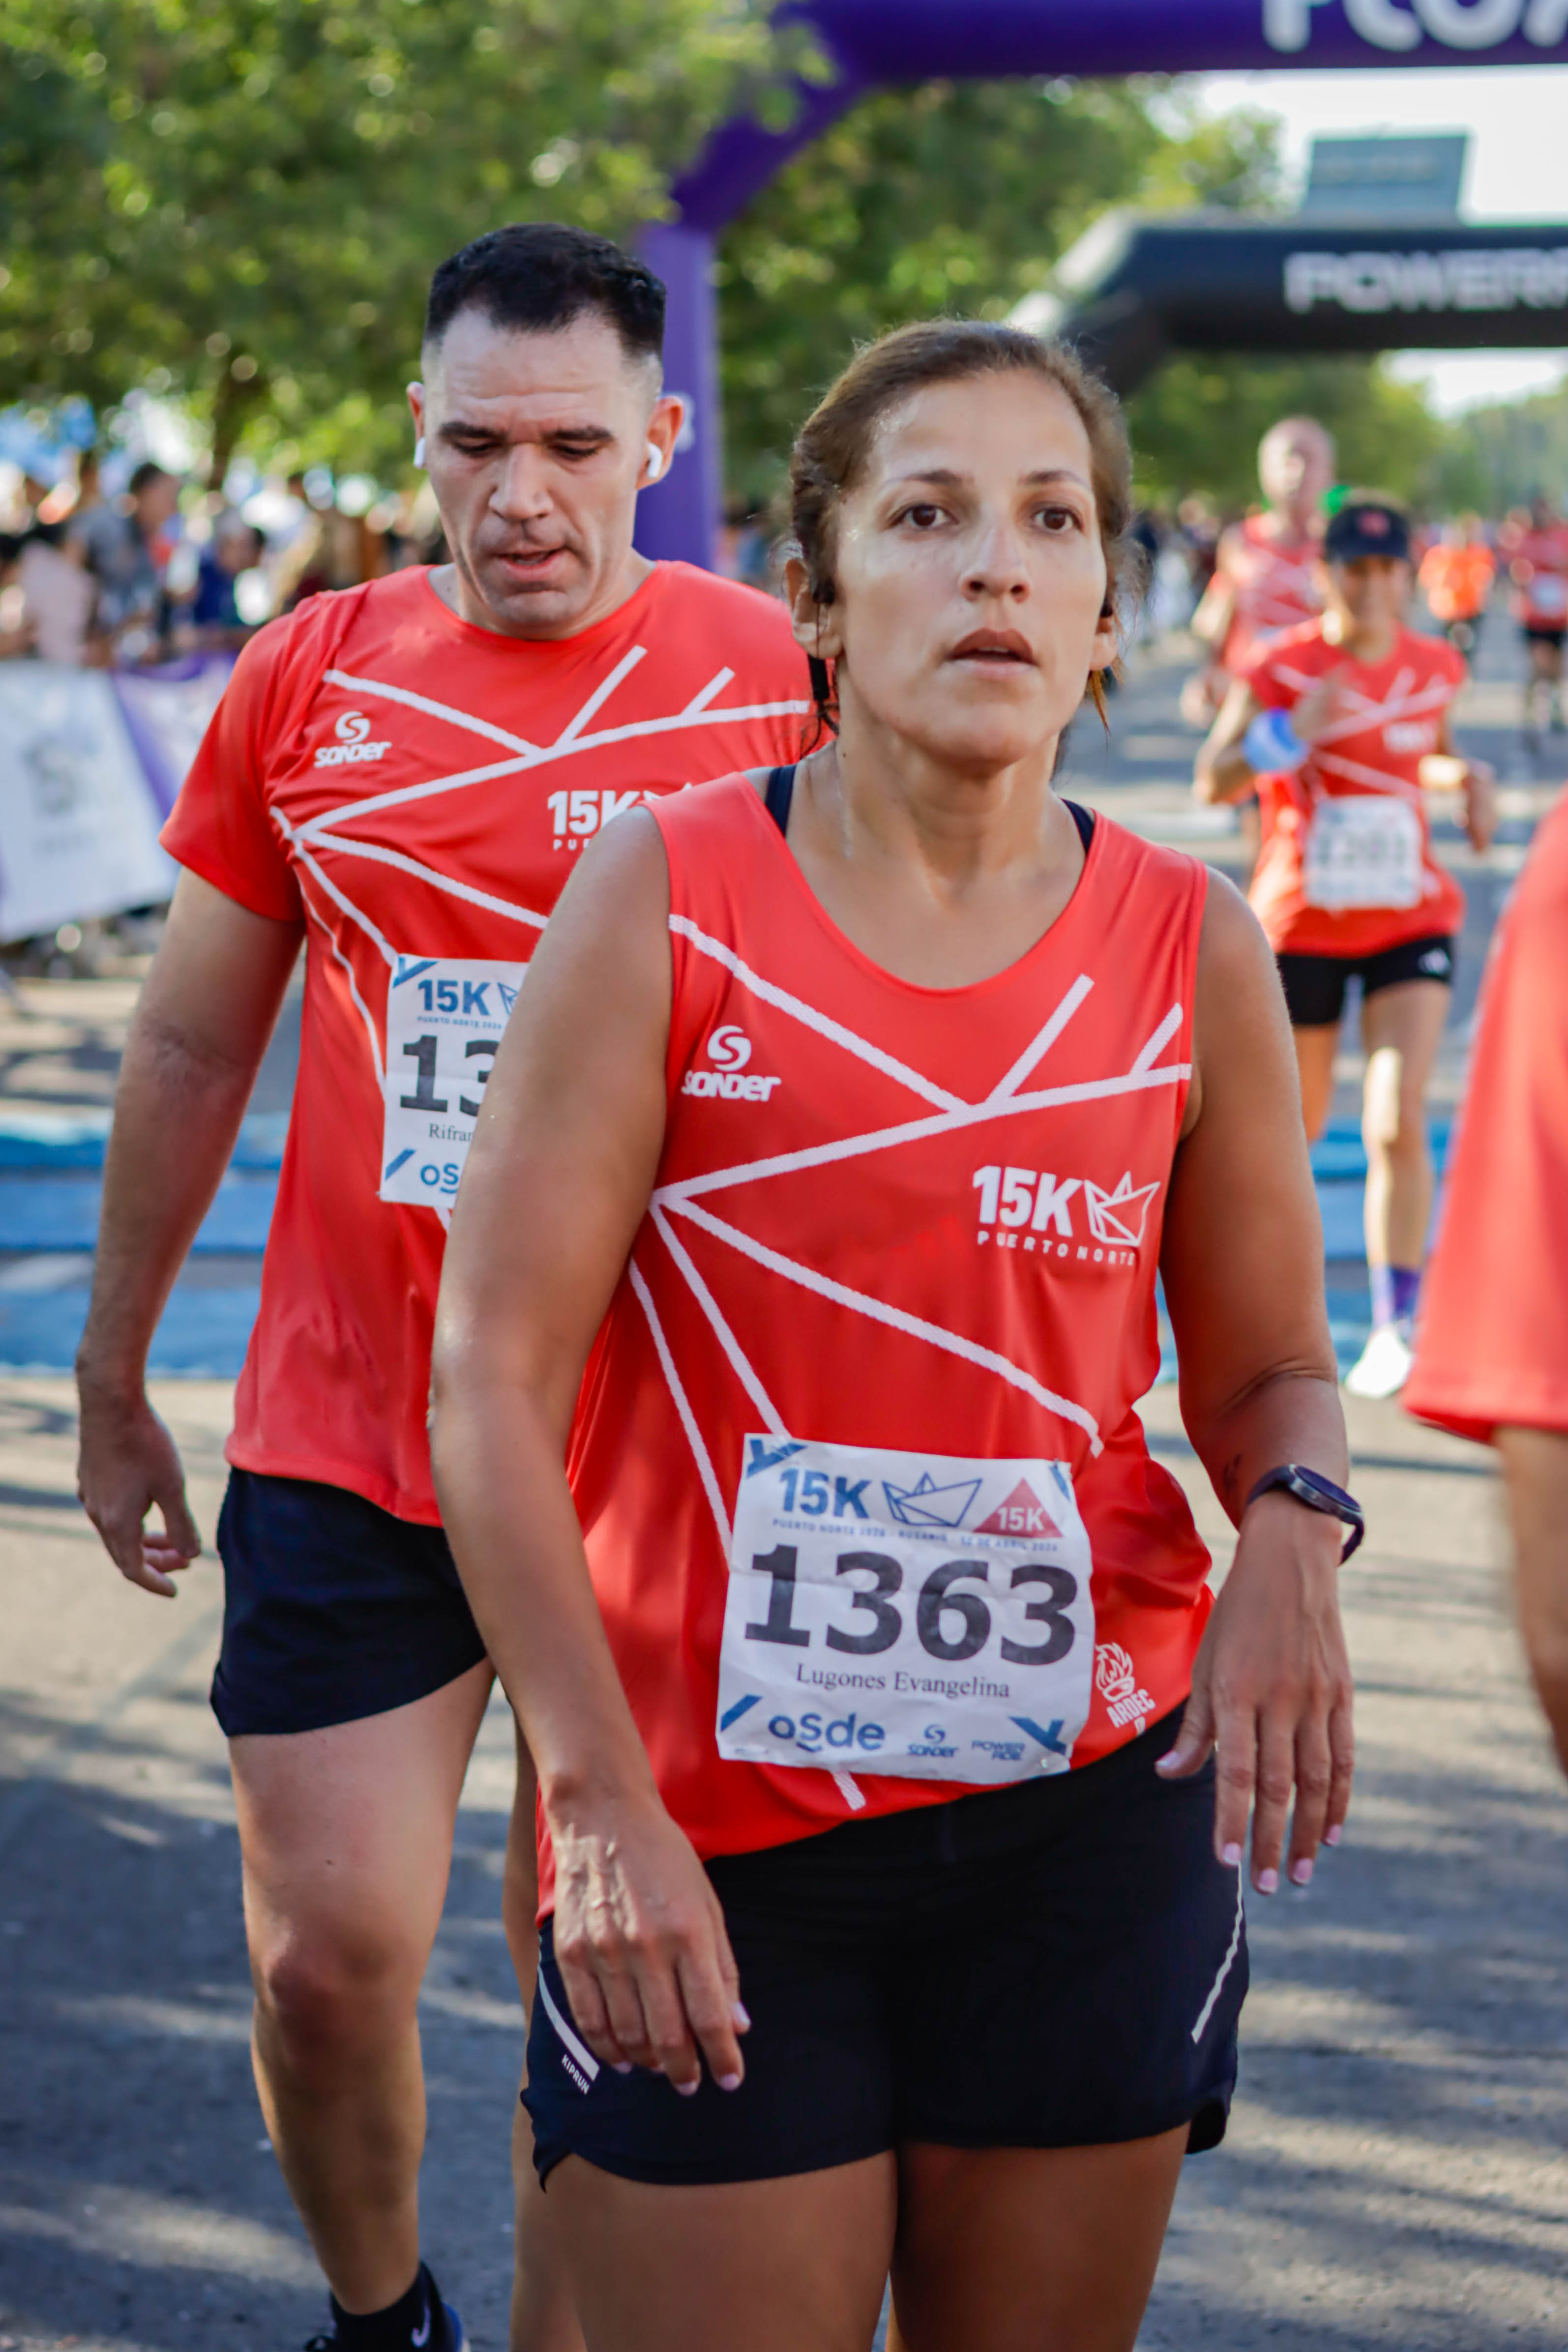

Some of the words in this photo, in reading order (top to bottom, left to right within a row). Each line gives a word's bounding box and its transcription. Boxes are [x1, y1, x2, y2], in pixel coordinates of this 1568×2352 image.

[547, 790, 641, 835] 15K
[418, 979, 491, 1016] 15K
[973, 1165, 1083, 1237] 15K
[977, 1230, 1068, 1258] PUERTO
[1076, 1245, 1135, 1266] NORTE
[779, 1468, 873, 1519] 15K
[997, 1506, 1045, 1531] 15K
[744, 1543, 1078, 1666] 1363
[796, 1663, 887, 1691] Lugones
[893, 1671, 1011, 1699] Evangelina
[1107, 1688, 1156, 1728] ARDEC
[562, 2054, 590, 2095] KIPRUN
